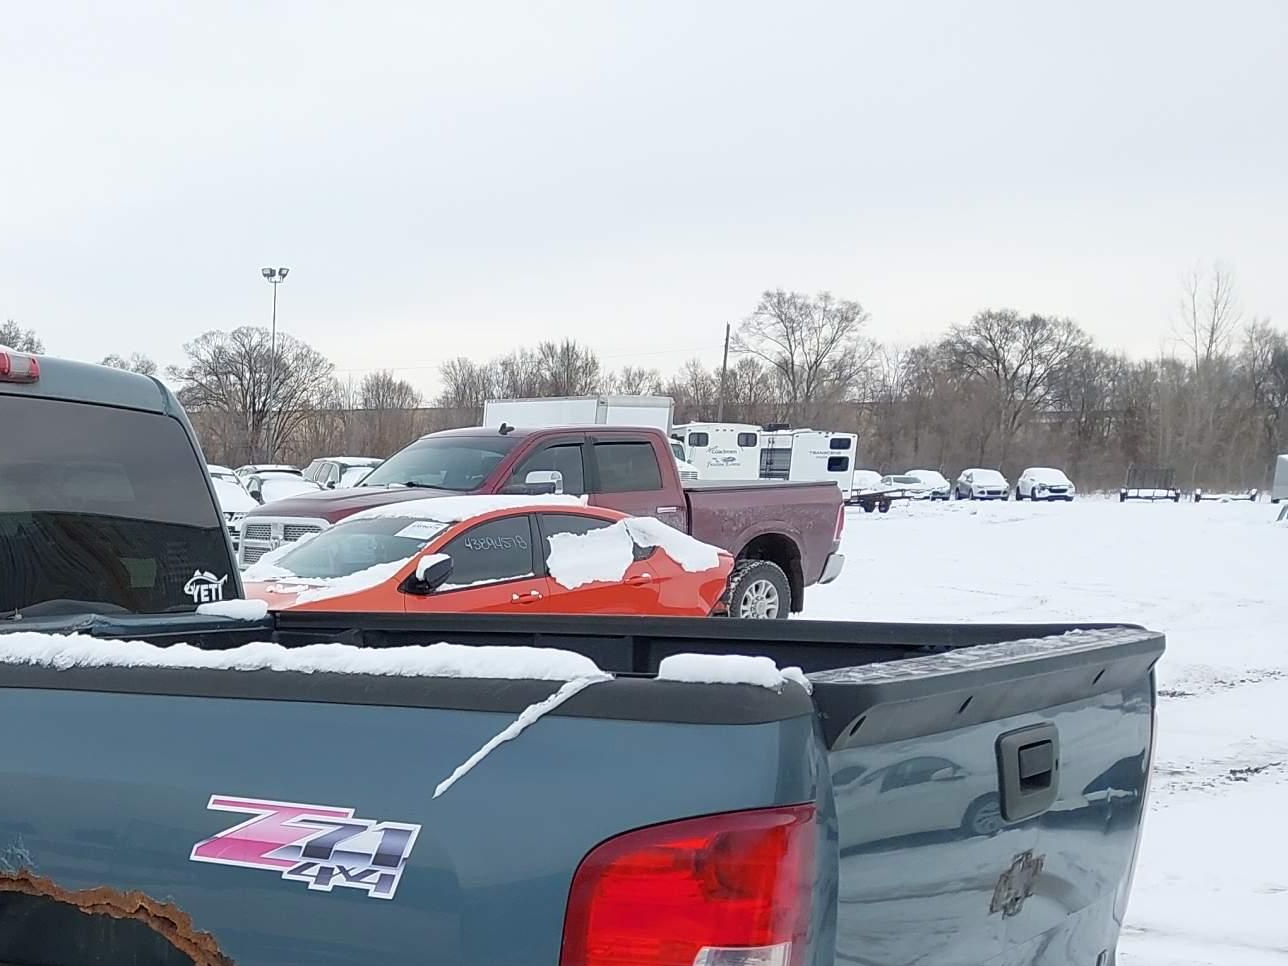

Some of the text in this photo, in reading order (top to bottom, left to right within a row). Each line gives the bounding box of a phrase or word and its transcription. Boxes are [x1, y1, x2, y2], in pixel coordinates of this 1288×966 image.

[464, 535, 529, 551] 43894578
[193, 583, 223, 603] YETI
[189, 794, 422, 874] Z71
